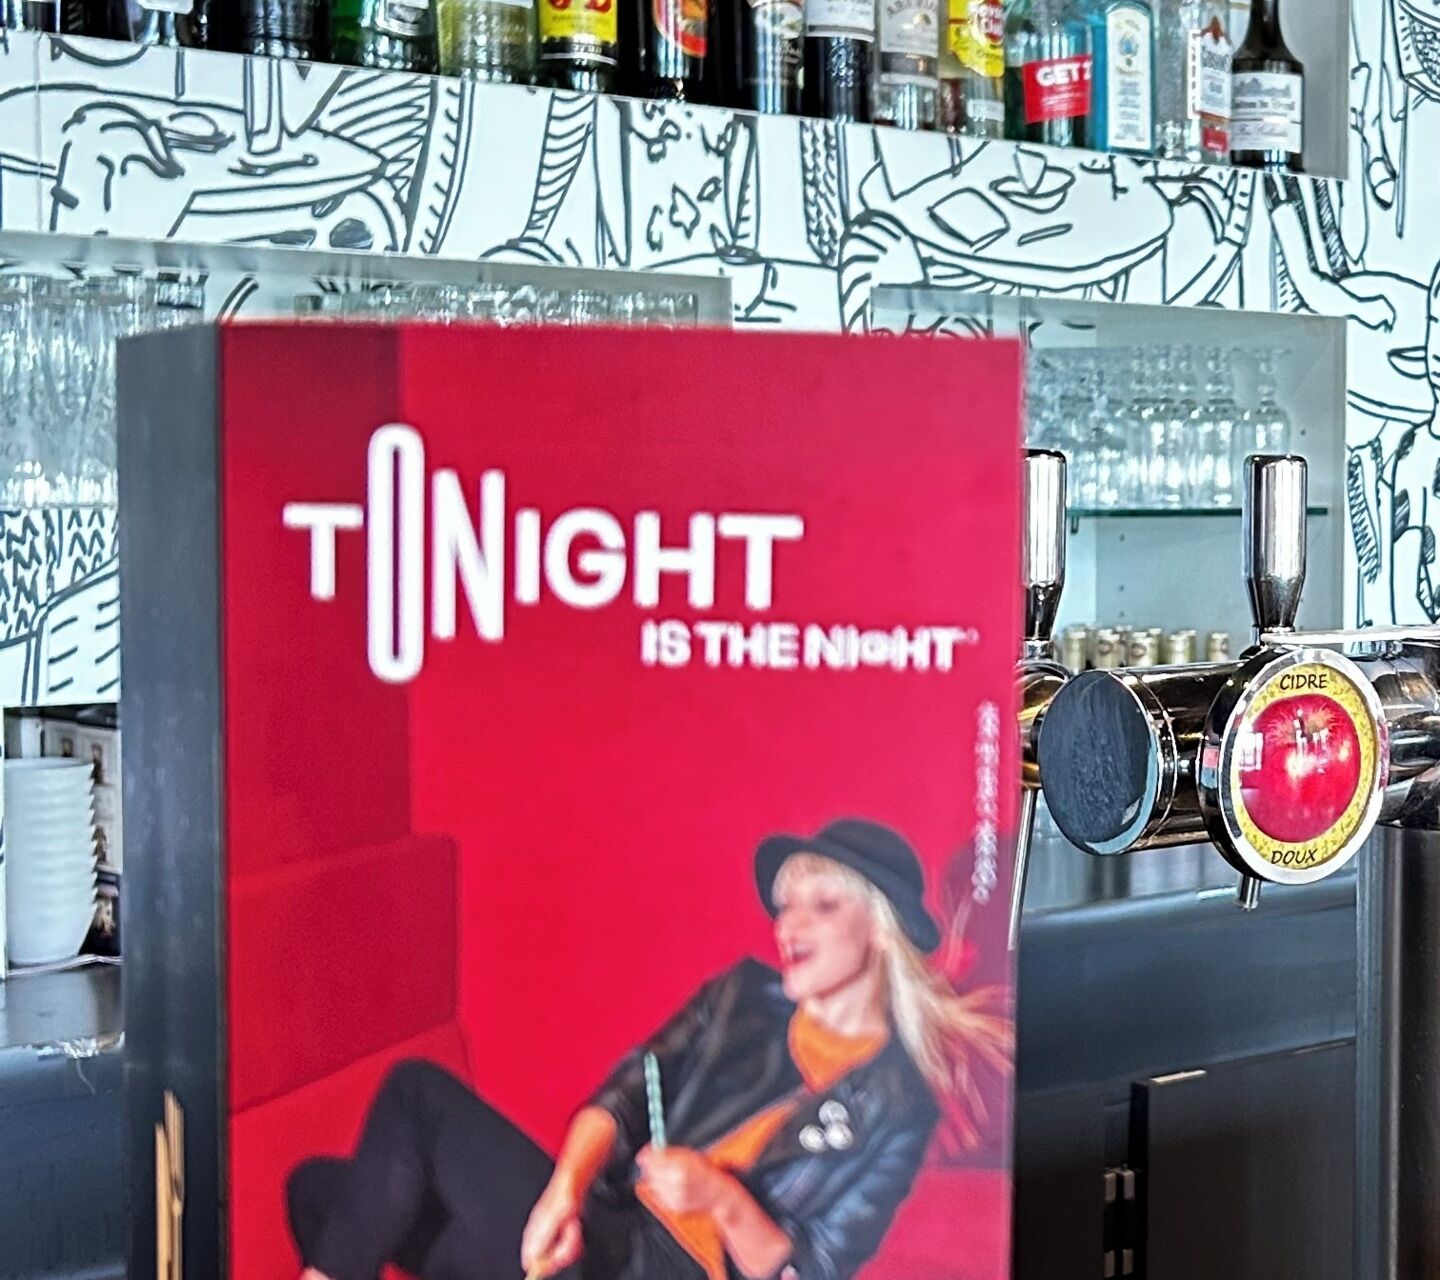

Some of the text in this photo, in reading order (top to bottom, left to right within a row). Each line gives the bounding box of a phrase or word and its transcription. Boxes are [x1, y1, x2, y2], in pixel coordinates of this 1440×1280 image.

[1036, 62, 1080, 87] GET
[282, 421, 804, 684] TONIGHT
[640, 618, 961, 672] IS THE NIGHT
[1279, 673, 1328, 691] CIDRE
[1270, 848, 1319, 865] DOUX
